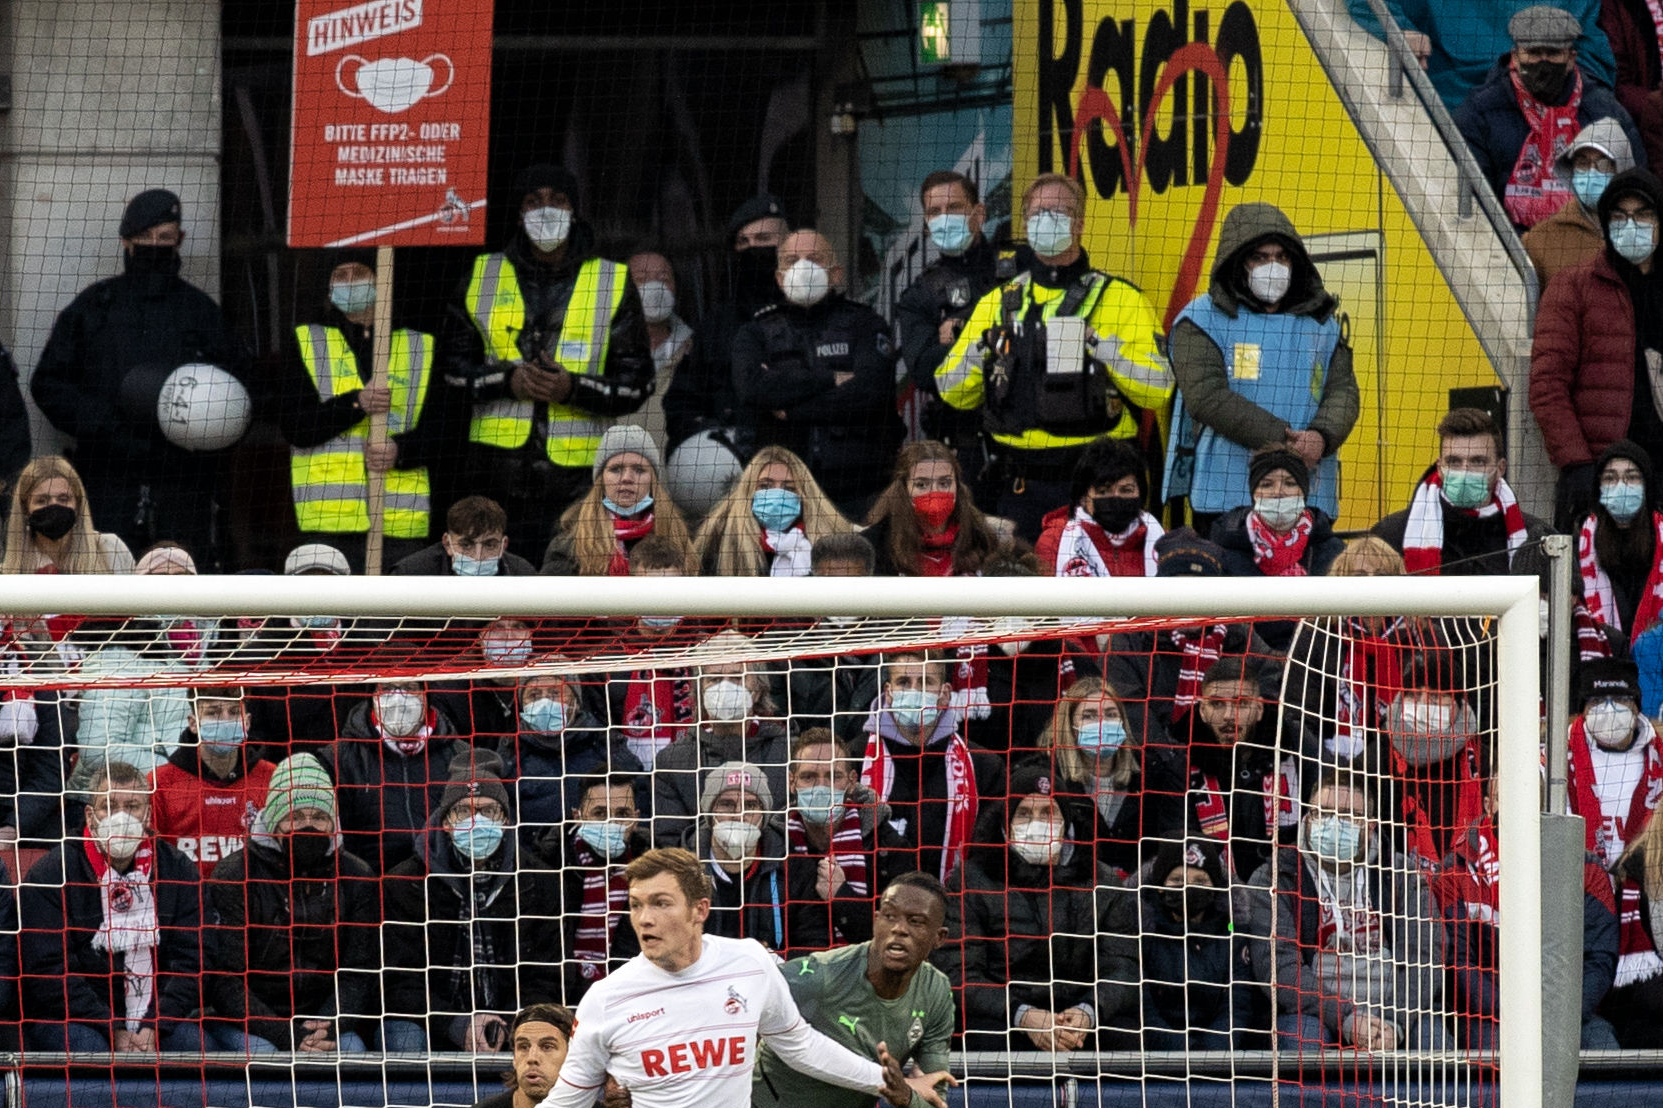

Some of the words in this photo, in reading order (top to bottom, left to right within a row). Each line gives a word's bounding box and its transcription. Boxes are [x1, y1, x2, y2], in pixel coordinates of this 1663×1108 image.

[313, 0, 417, 48] HINWEIS
[1038, 0, 1264, 200] Radio
[324, 124, 366, 141] BITTE
[420, 122, 461, 140] ODER
[338, 145, 446, 163] MEDIZINISCHE
[335, 168, 384, 185] MASKE
[390, 168, 447, 185] TRAGEN
[177, 836, 245, 862] REW
[627, 1007, 666, 1023] uhlsport
[640, 1036, 746, 1078] REWE
